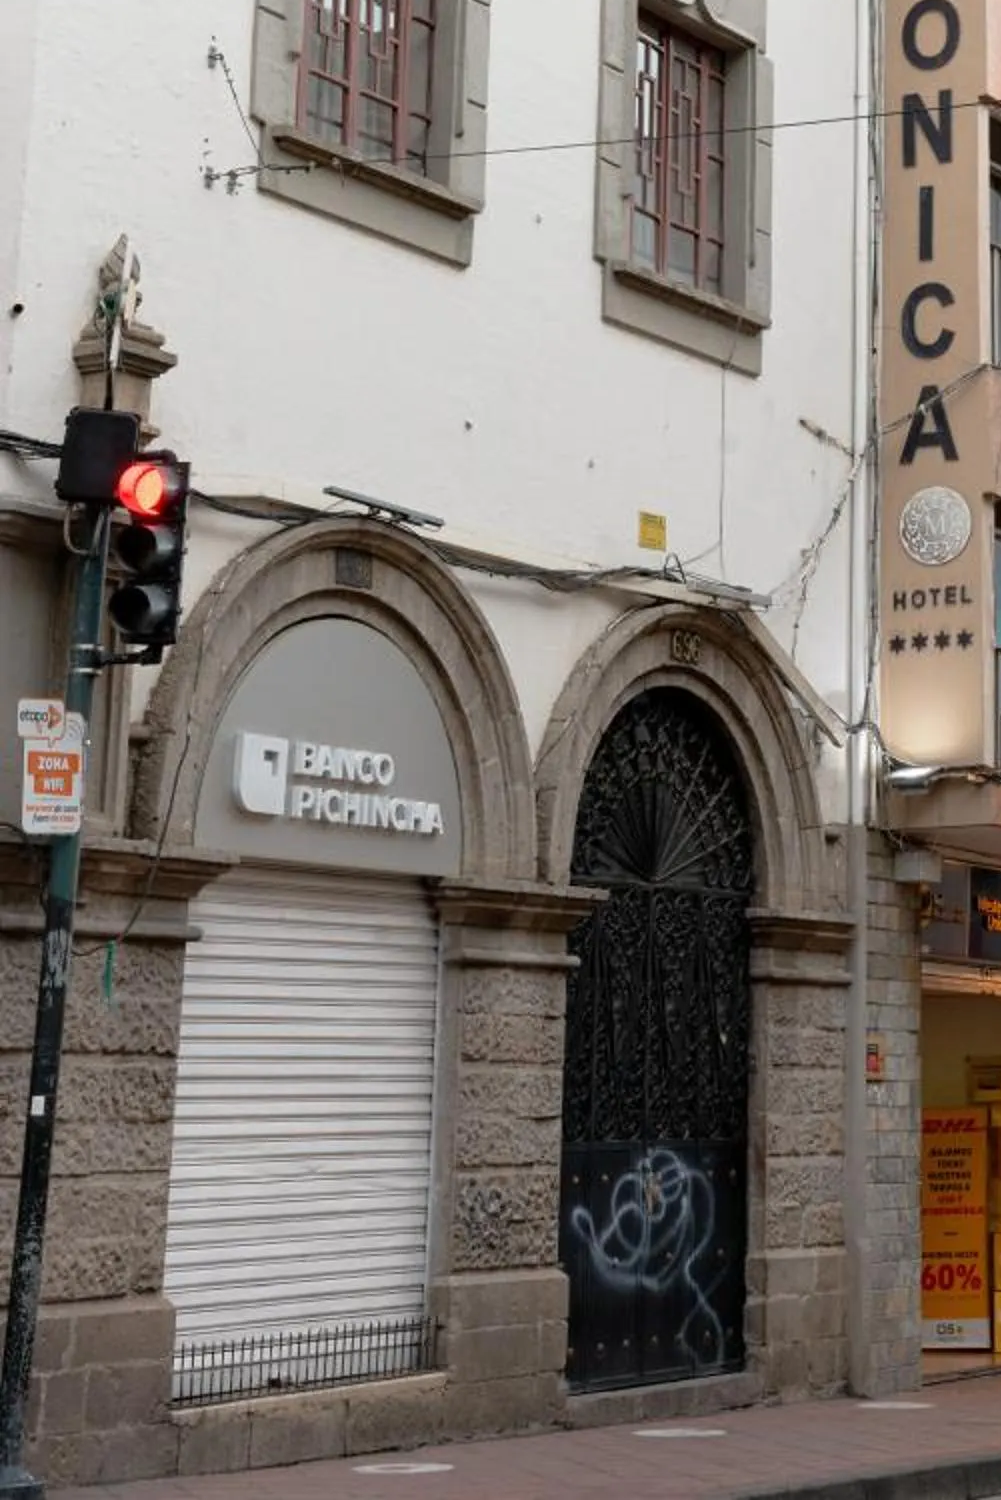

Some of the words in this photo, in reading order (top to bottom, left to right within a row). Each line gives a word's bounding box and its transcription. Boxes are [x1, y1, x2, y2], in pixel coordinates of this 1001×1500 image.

[892, 584, 973, 612] HOTEL
[293, 741, 395, 787] BANCO
[291, 784, 444, 835] PICHINCHA
[920, 1263, 982, 1292] 60%
